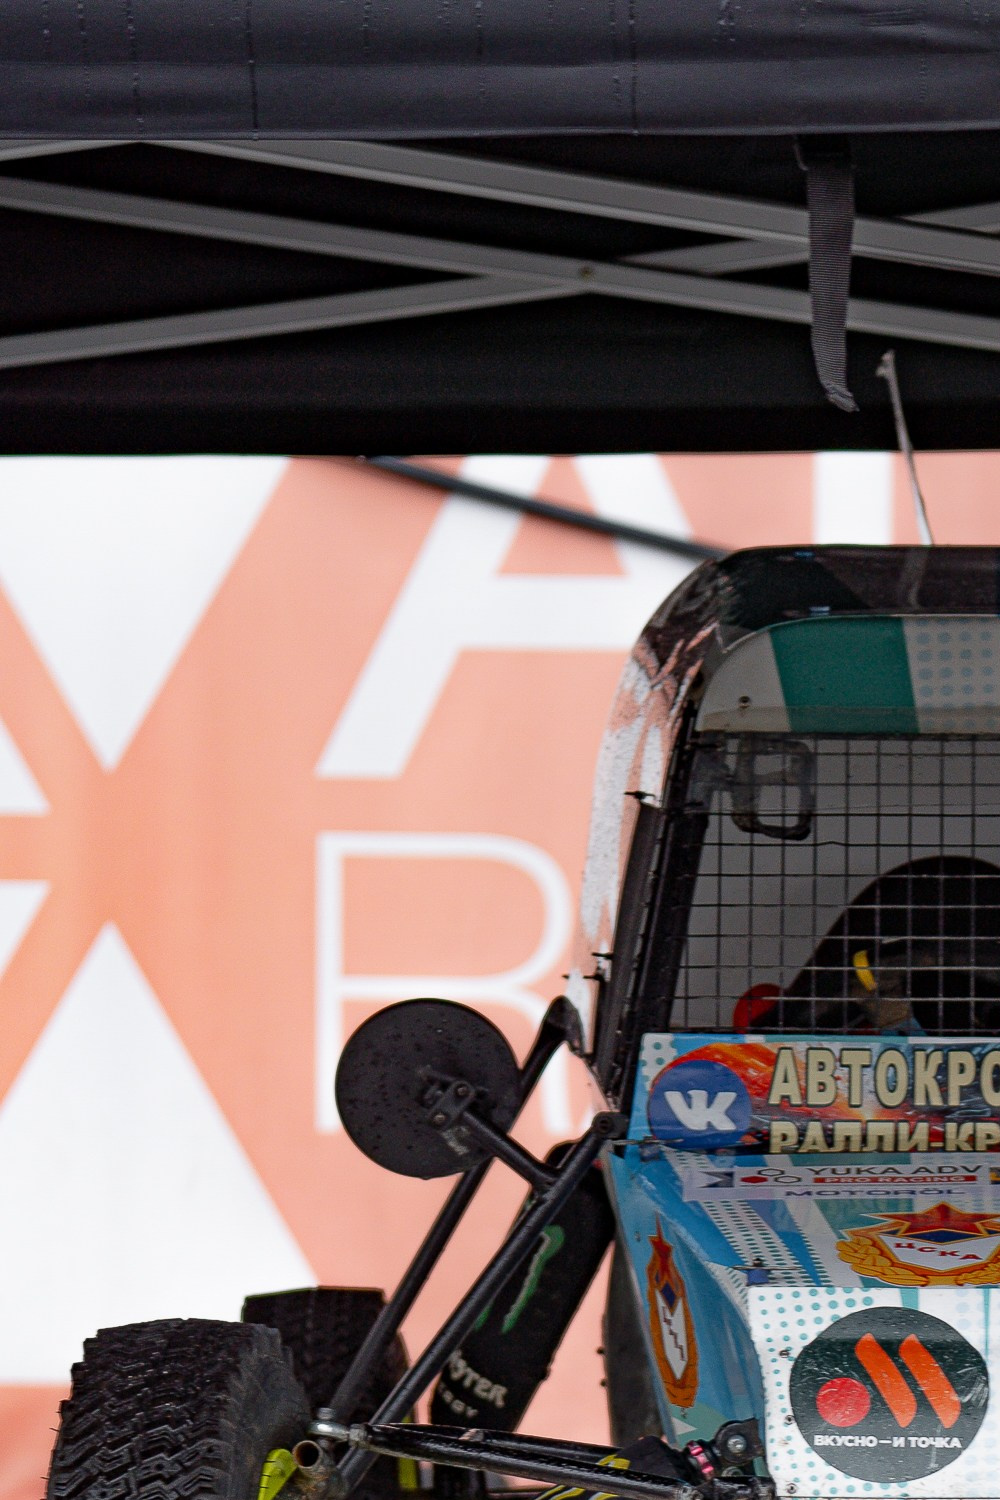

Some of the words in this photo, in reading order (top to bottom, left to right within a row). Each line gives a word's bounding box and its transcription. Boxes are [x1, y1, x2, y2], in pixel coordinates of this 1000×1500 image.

[808, 1165, 902, 1176] YUKA
[911, 1164, 983, 1175] ADV
[877, 1175, 966, 1183] RACING
[784, 1187, 966, 1197] MOTORÖL
[907, 1436, 963, 1448] ТОЧКА
